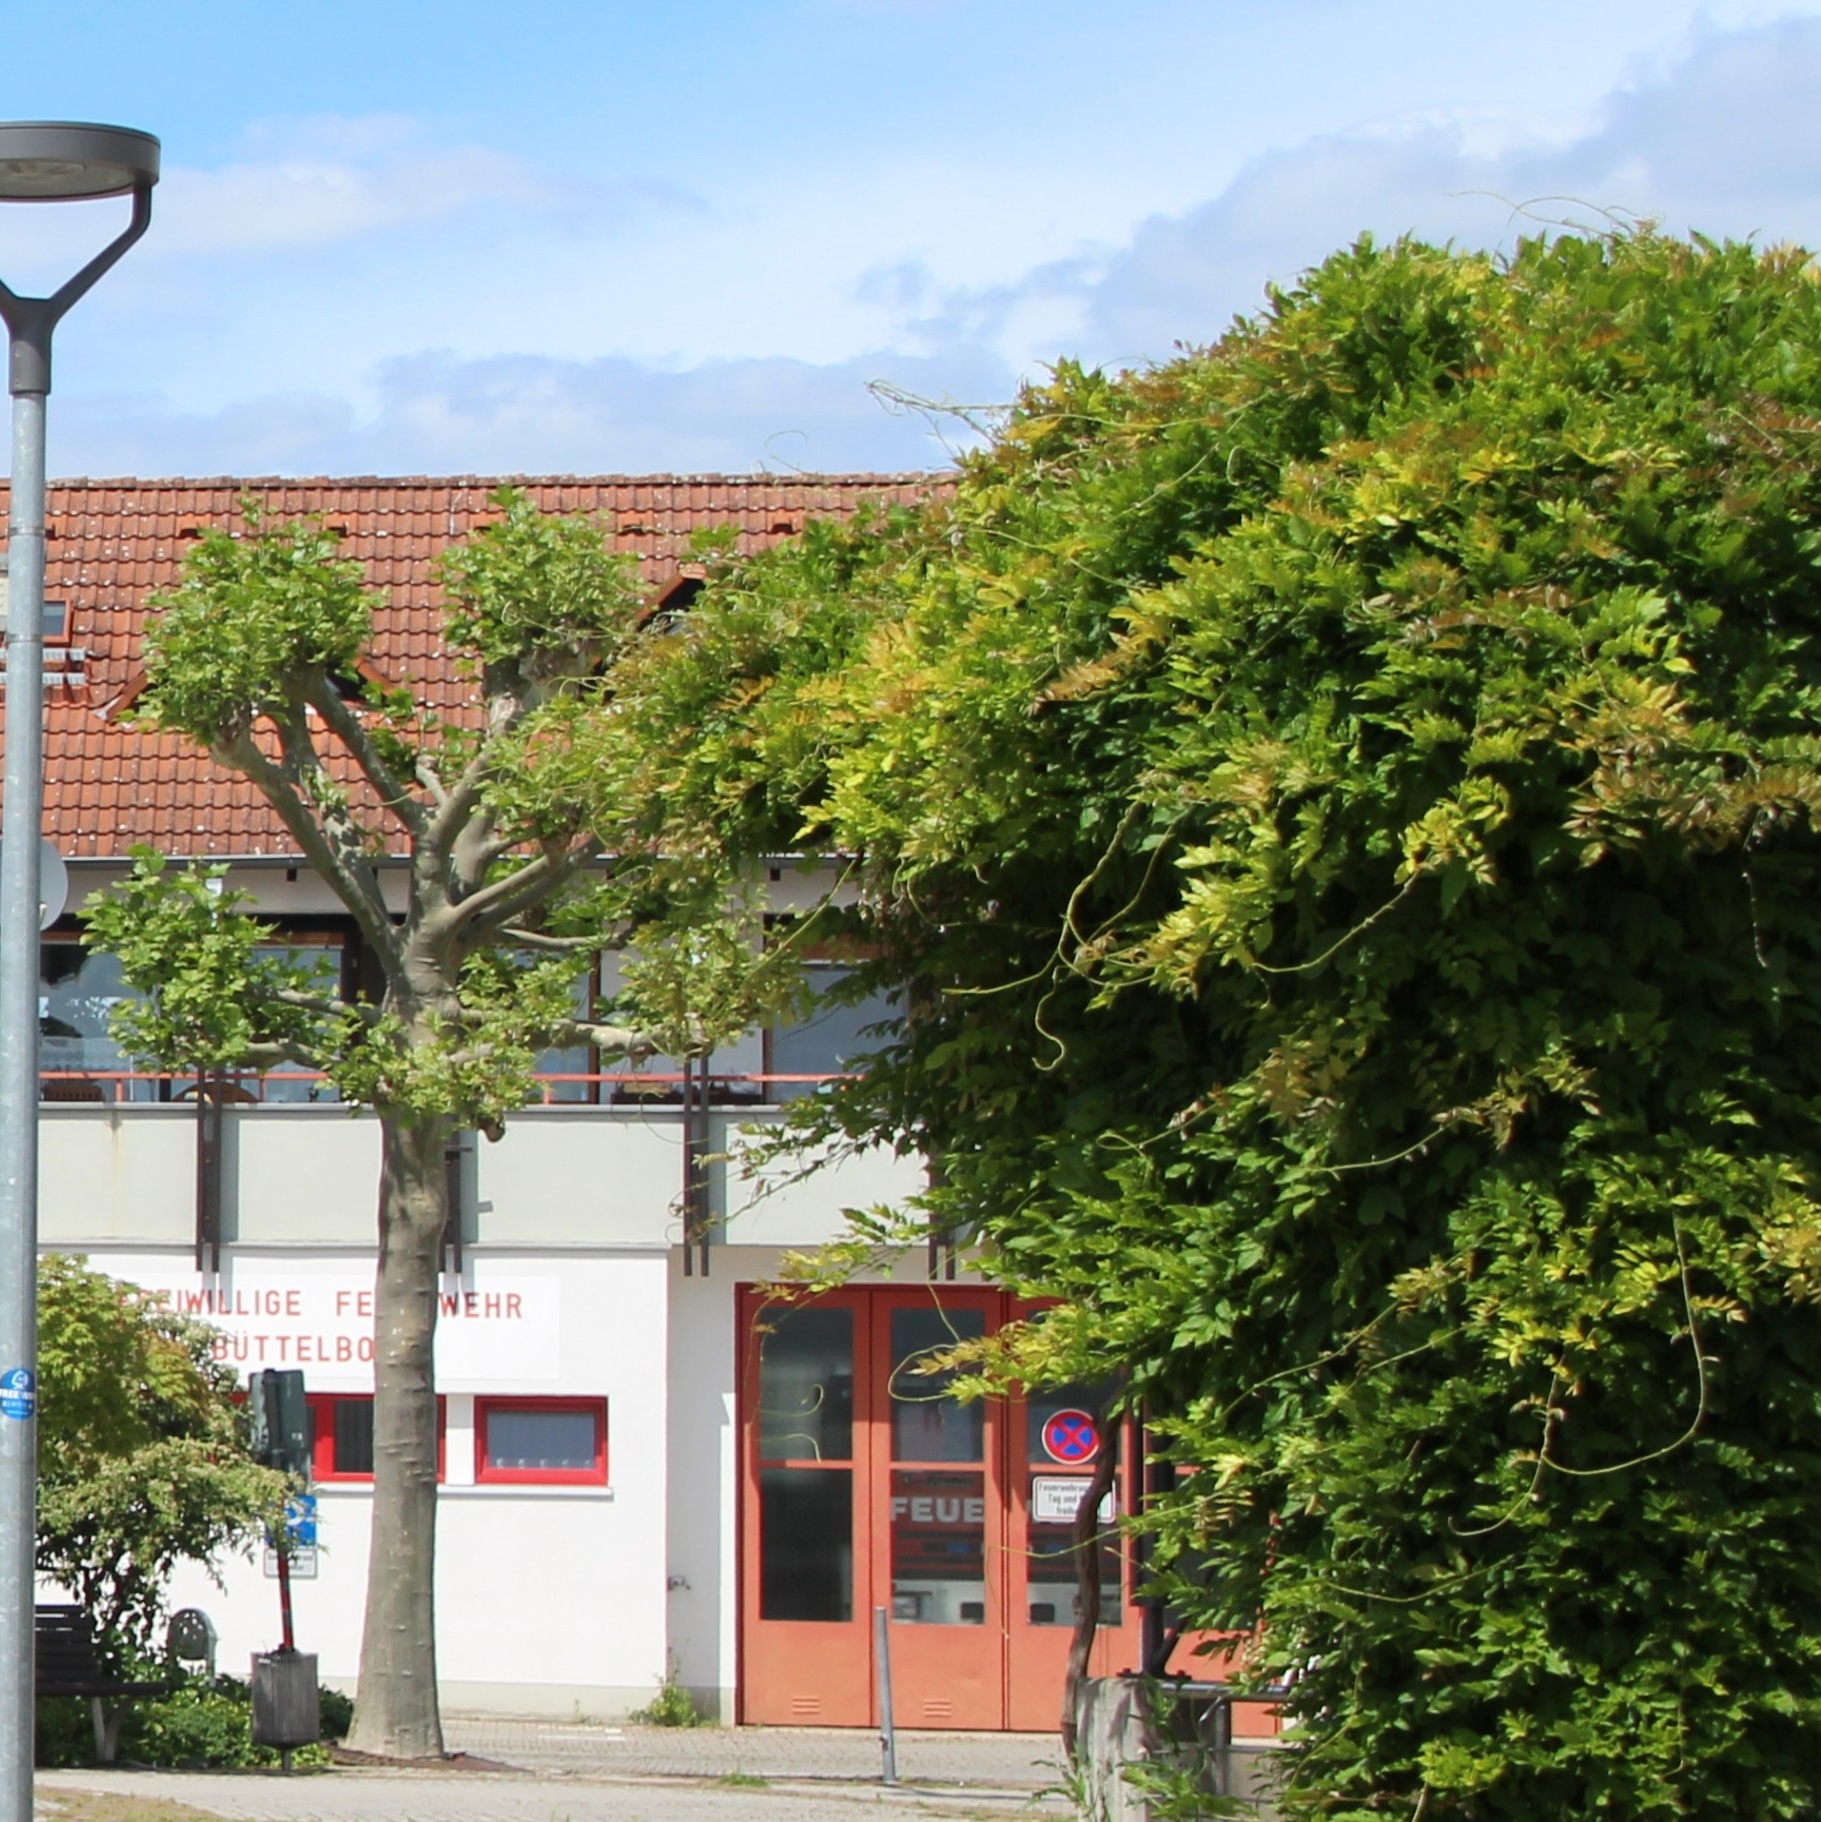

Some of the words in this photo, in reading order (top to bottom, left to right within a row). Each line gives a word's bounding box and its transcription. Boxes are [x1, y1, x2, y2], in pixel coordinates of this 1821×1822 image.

[117, 1289, 302, 1316] EIWILLIGE
[336, 1291, 523, 1319] FEWEHR
[212, 1330, 376, 1362] BÜTTELBO
